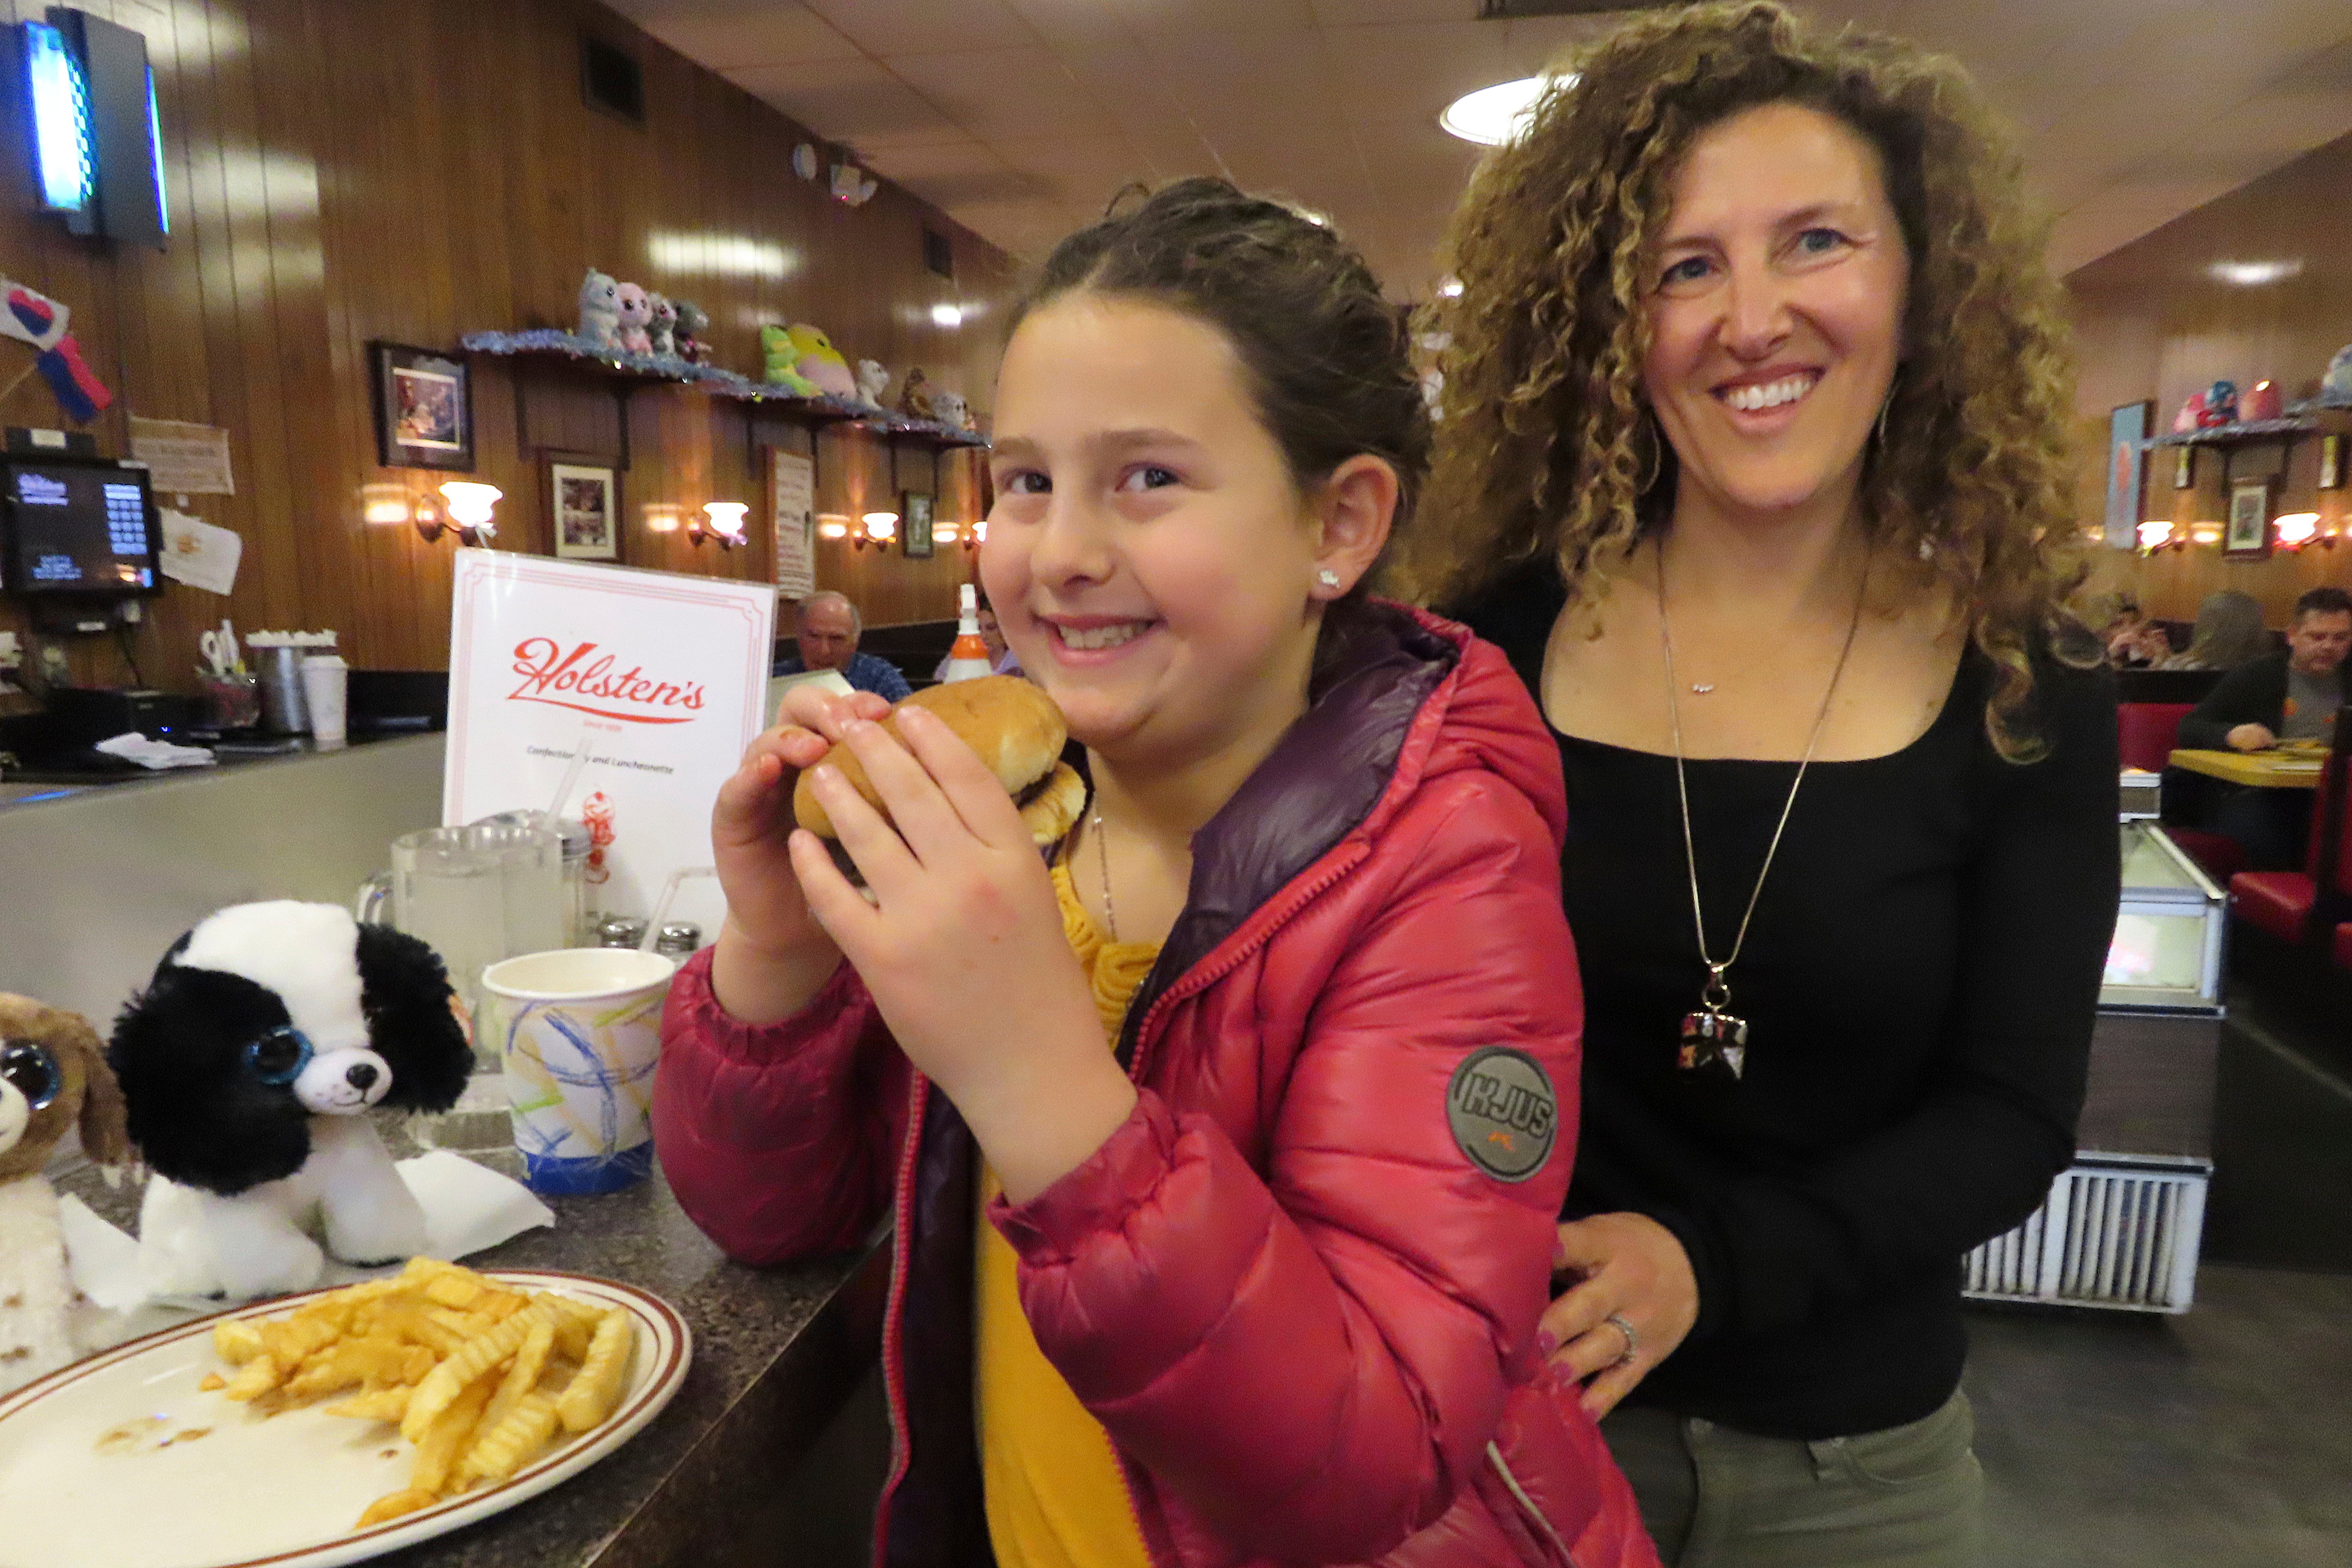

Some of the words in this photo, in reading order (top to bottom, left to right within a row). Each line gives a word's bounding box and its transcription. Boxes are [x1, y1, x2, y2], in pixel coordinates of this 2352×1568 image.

[506, 637, 706, 710] Holsten's
[527, 744, 591, 763] Confectiony
[592, 757, 610, 765] and
[611, 757, 674, 774] Luncheonette
